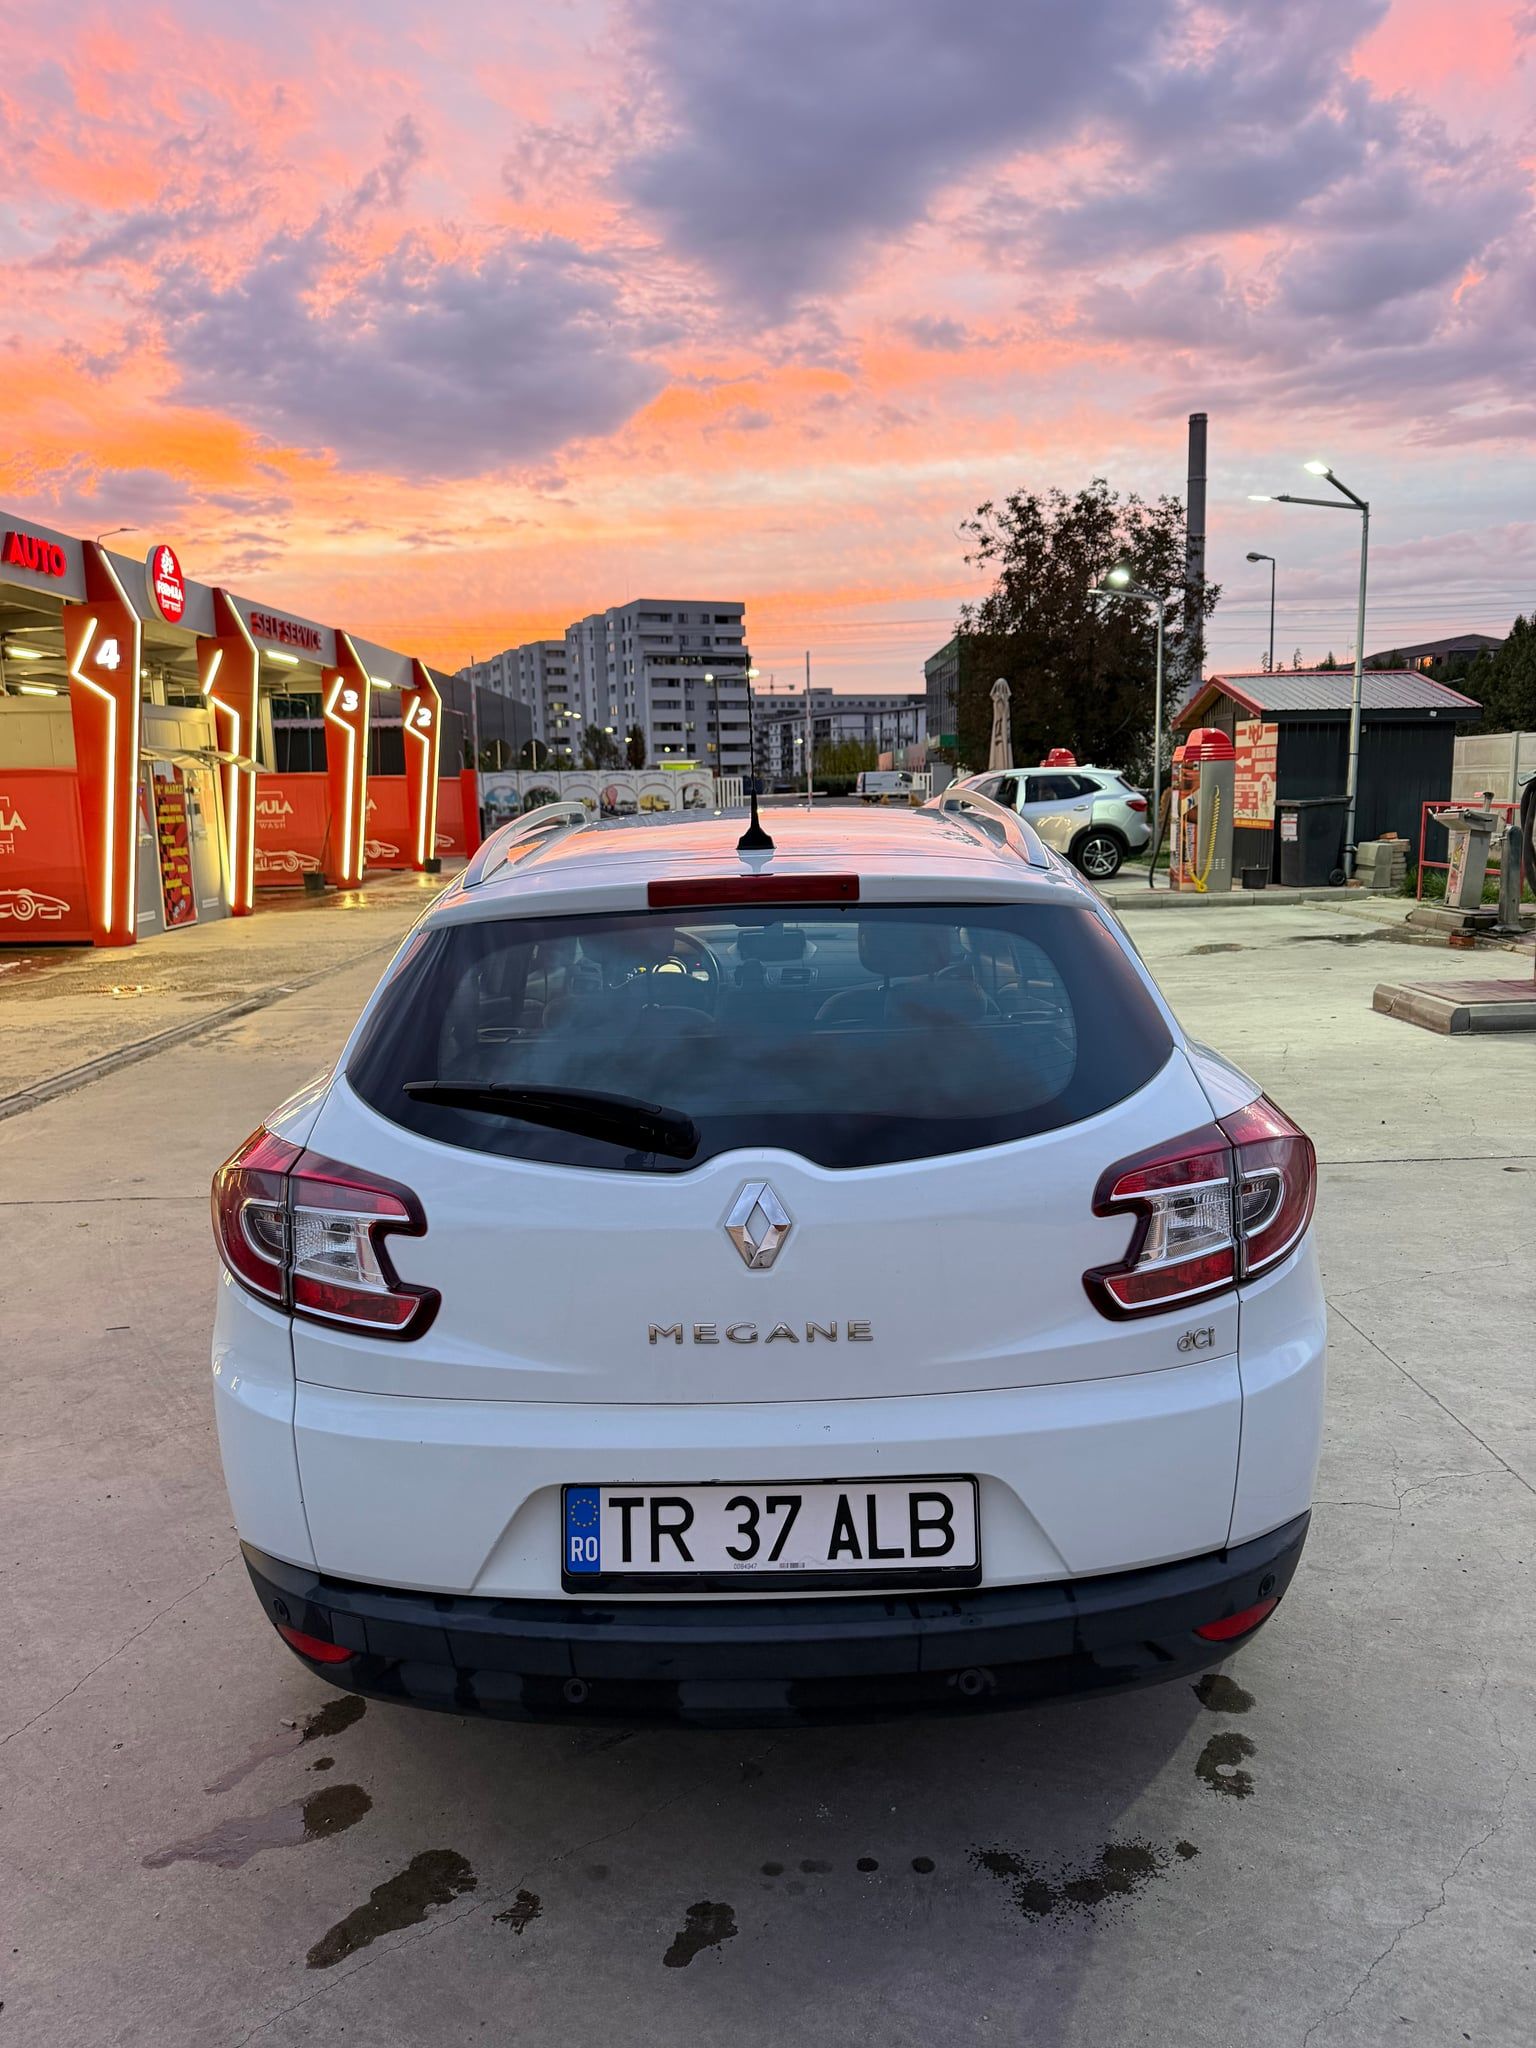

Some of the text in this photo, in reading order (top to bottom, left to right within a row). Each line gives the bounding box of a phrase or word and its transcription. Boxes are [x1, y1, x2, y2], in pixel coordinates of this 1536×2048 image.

[4, 531, 67, 578] AUTO
[251, 612, 322, 652] SELF SERVICE
[96, 639, 120, 670] 4
[342, 690, 359, 712] 3
[416, 708, 432, 726] 2
[648, 1320, 873, 1345] MEGANE
[608, 1492, 955, 1563] TR 37 ALB
[571, 1536, 598, 1562] RO
